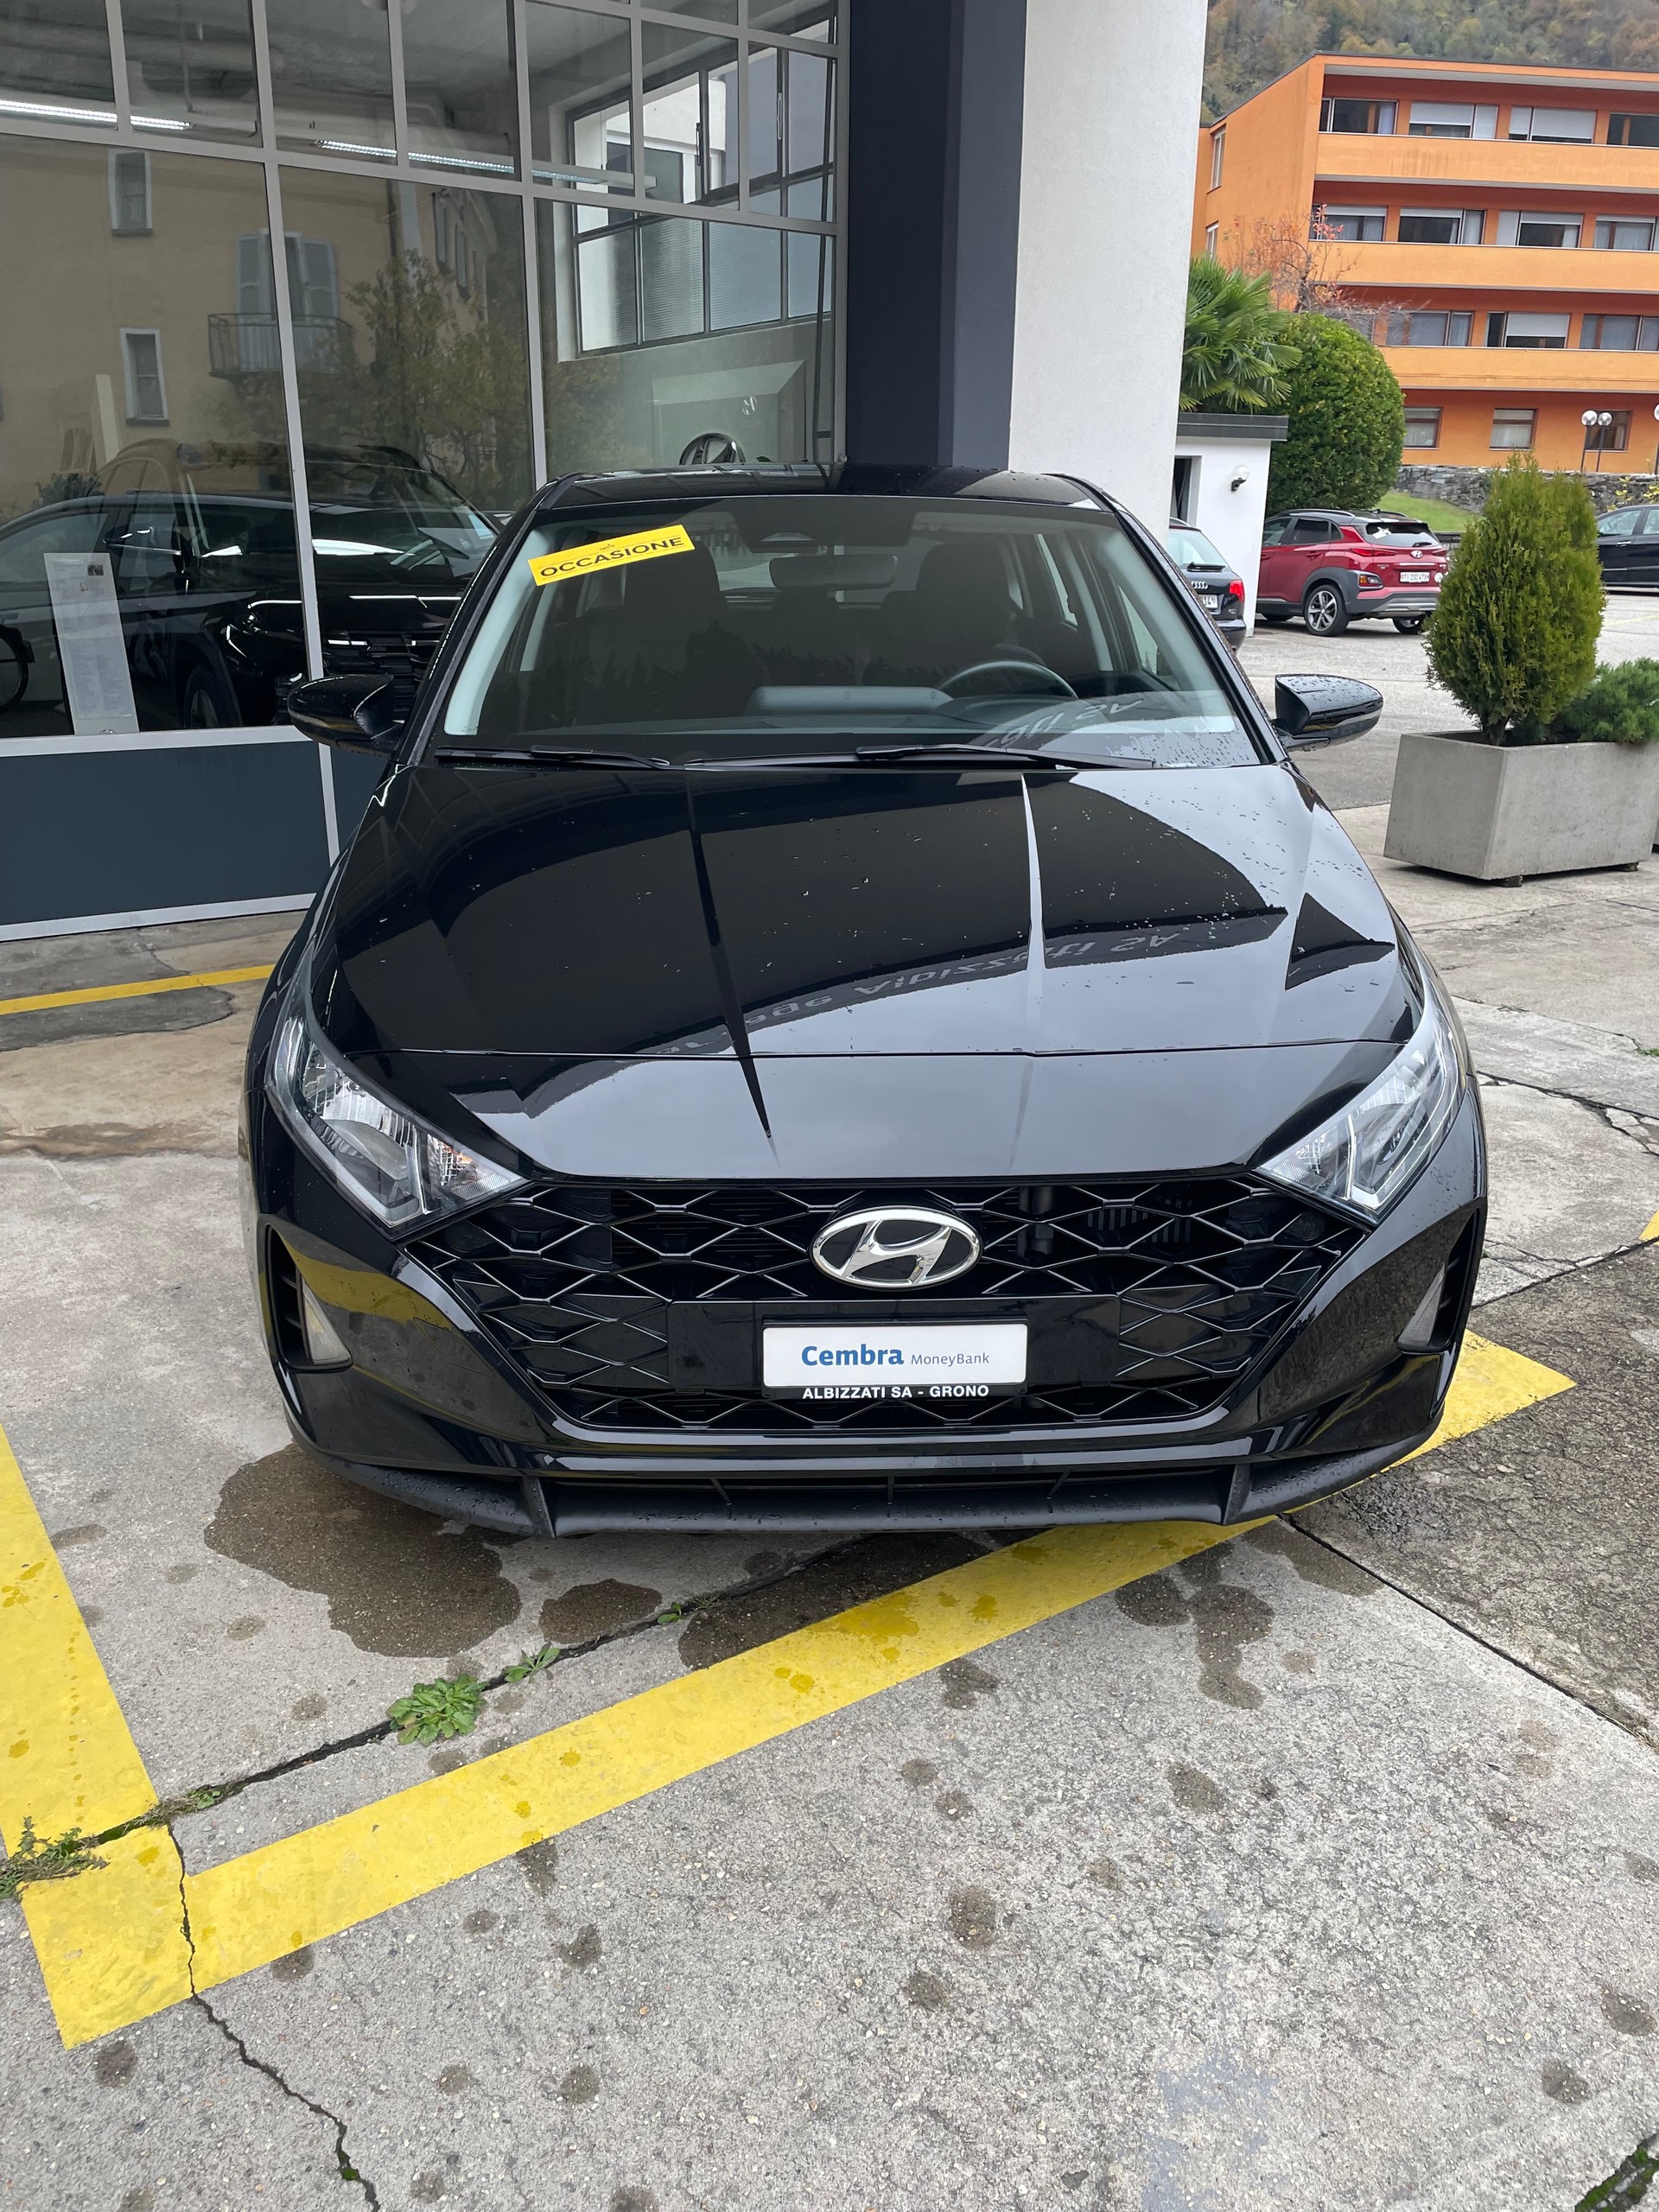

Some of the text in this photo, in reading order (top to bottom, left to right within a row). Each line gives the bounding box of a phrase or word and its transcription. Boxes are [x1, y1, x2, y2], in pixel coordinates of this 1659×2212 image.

[540, 537, 684, 577] OCCASIONE
[801, 1343, 990, 1368] Cembra MoneyBank
[802, 1385, 886, 1400] ALBIZZATI
[890, 1384, 912, 1399] SA
[929, 1384, 989, 1398] GRONO
